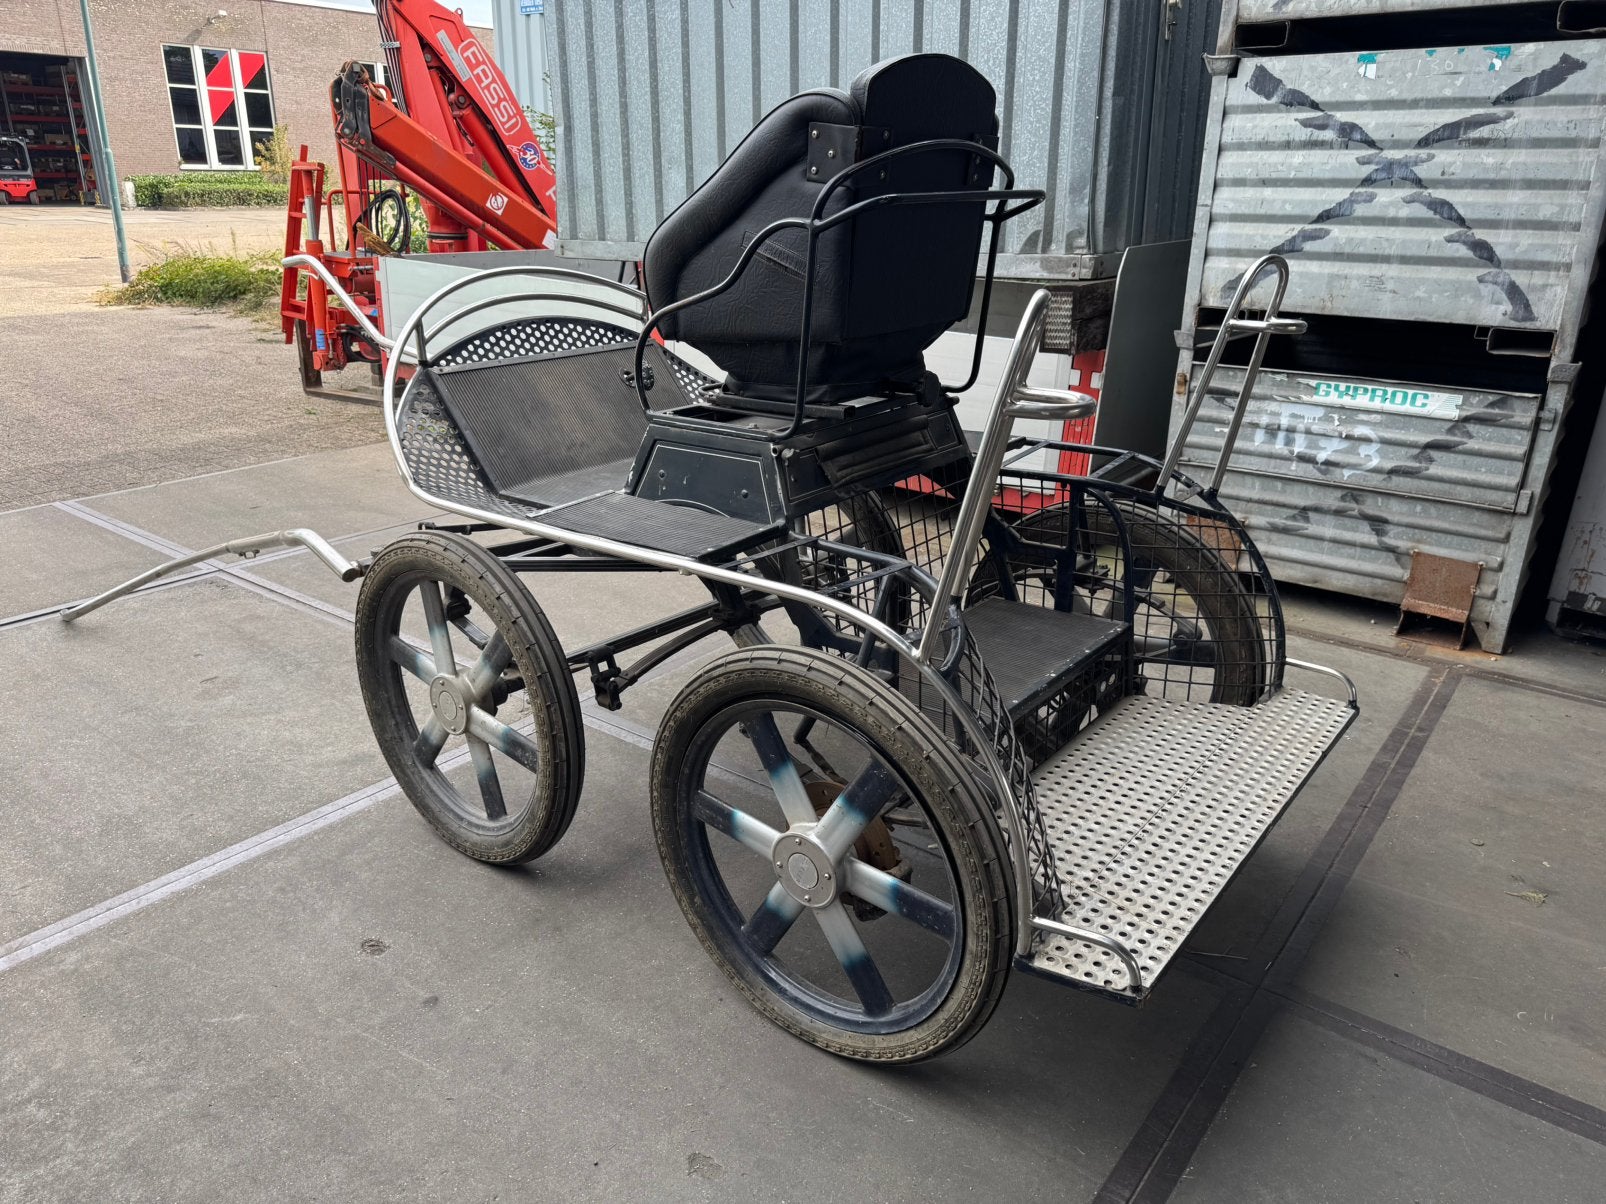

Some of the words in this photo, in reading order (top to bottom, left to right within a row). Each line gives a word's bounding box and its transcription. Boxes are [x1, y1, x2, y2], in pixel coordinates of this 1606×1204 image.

[463, 45, 516, 129] FASSI
[519, 148, 539, 165] 30
[1314, 381, 1430, 409] GYPROC
